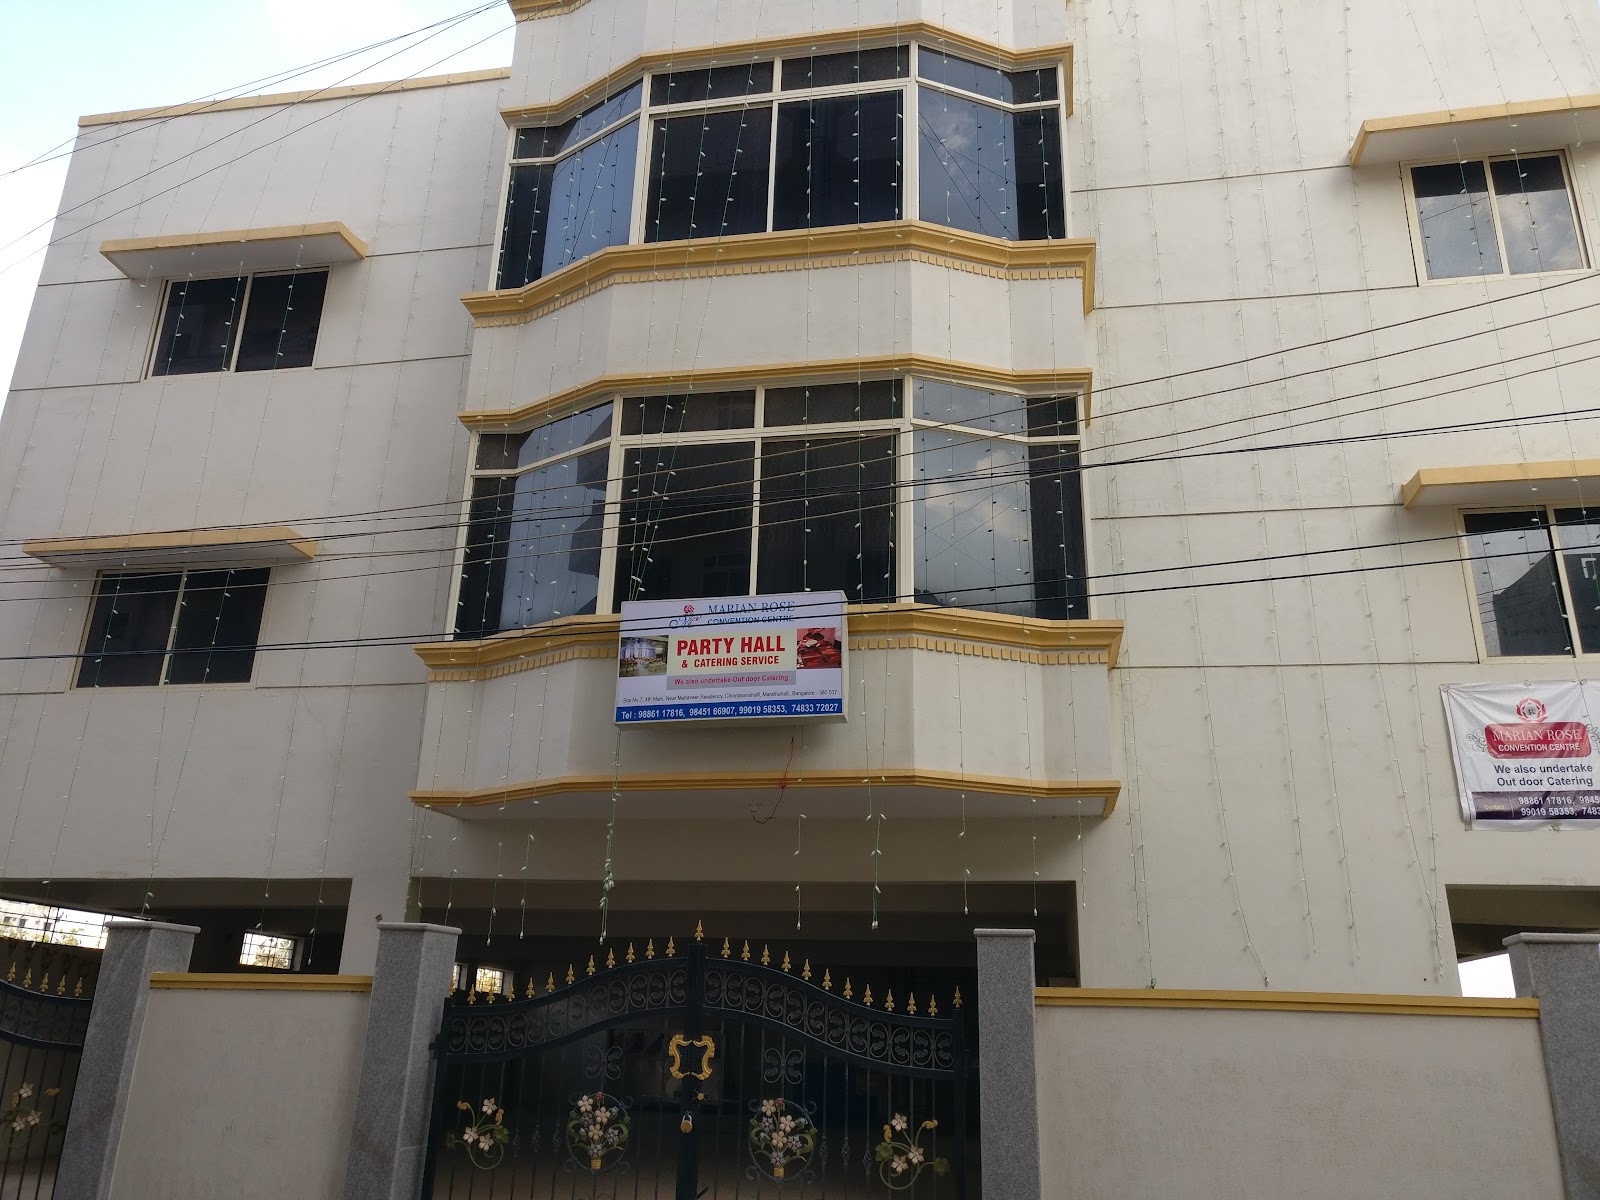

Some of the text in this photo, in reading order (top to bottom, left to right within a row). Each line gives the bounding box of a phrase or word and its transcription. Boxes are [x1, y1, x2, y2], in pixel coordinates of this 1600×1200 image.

[708, 601, 795, 614] MARIAN ROSE
[677, 636, 786, 656] PARTY HALL
[682, 656, 780, 668] & CATERING SERVICE
[621, 712, 632, 720] Tel
[638, 710, 660, 718] 98861
[662, 708, 686, 718] 17816,
[689, 708, 711, 716] 98451
[713, 706, 737, 716] 66907,
[739, 706, 761, 714] 99019
[763, 704, 788, 714] 58353,
[792, 704, 814, 712] 74833
[816, 703, 838, 712] 72027
[1492, 728, 1582, 742] MARIAN ROSE
[1498, 742, 1580, 752] CONVENTION CENTRE
[1494, 764, 1593, 774] We also undertake
[1497, 776, 1594, 787] Out door Catering
[1518, 796, 1544, 806] 98861
[1546, 796, 1575, 806] 17816,
[1520, 806, 1546, 816] 99019
[1548, 806, 1578, 816] 58353,
